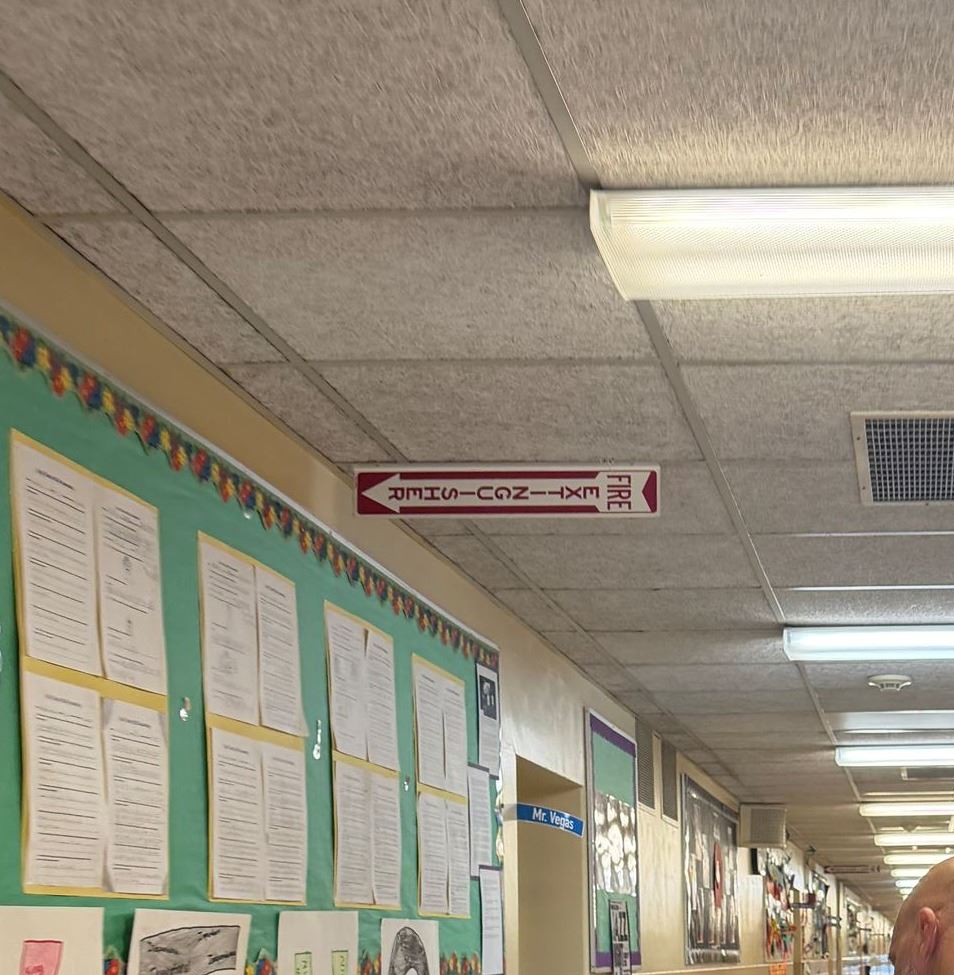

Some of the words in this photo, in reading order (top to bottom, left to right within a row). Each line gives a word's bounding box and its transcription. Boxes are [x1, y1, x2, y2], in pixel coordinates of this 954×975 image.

[387, 485, 600, 501] EXTINGUISHER
[607, 474, 632, 510] FIRE
[532, 807, 547, 822] Mr.
[550, 811, 574, 830] Vegas
